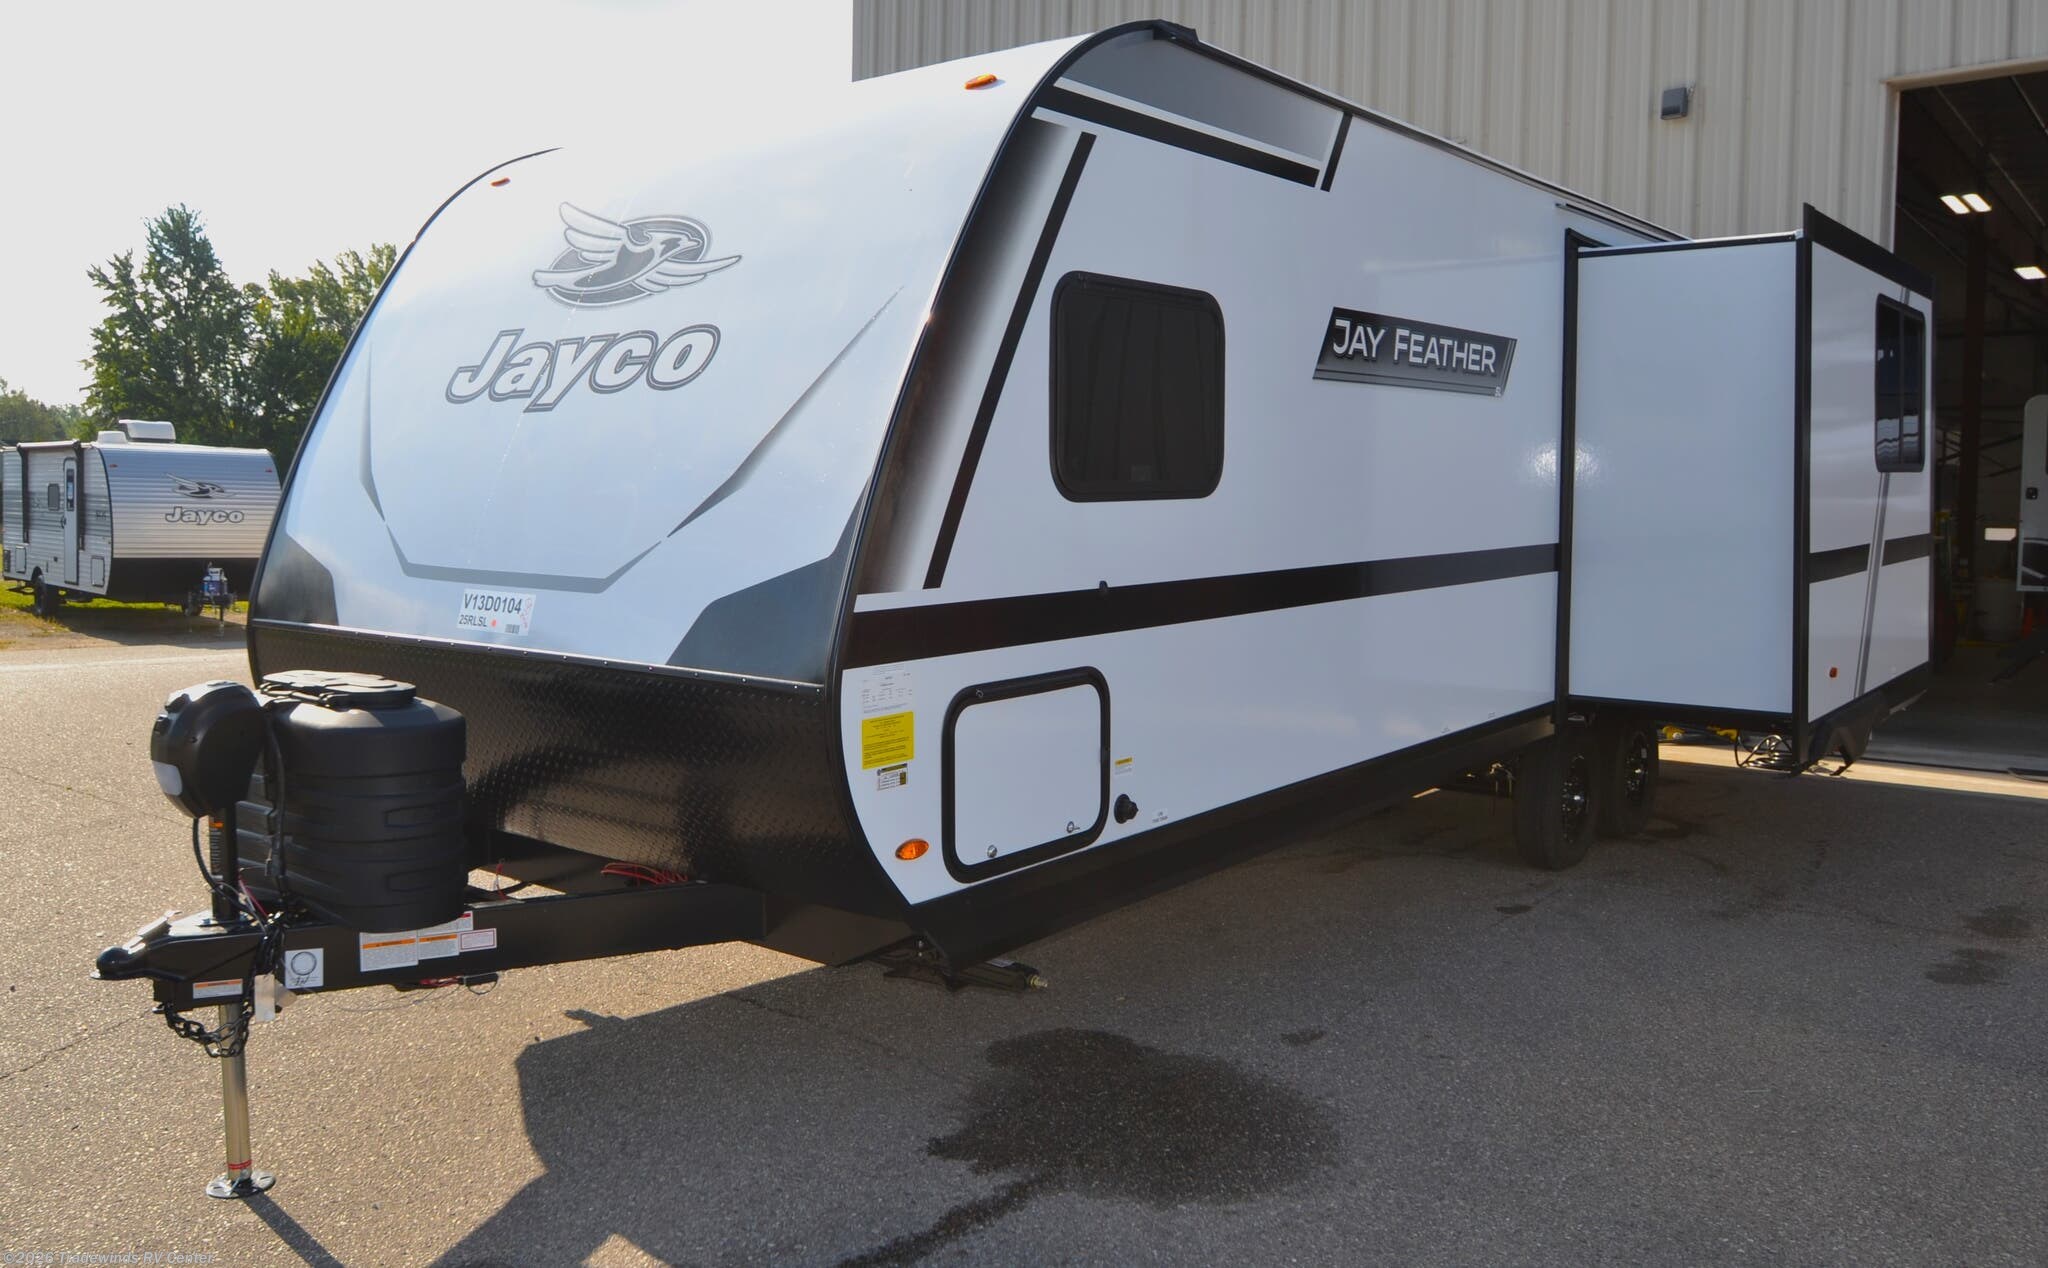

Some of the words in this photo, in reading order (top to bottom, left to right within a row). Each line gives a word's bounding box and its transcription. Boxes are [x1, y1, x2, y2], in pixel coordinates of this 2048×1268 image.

[1333, 318, 1386, 359] JAY
[1394, 327, 1497, 374] FEATHER
[445, 323, 721, 413] Jayco
[165, 506, 244, 525] Jayco
[463, 593, 522, 614] V13D0104
[458, 614, 488, 628] 25RLSL
